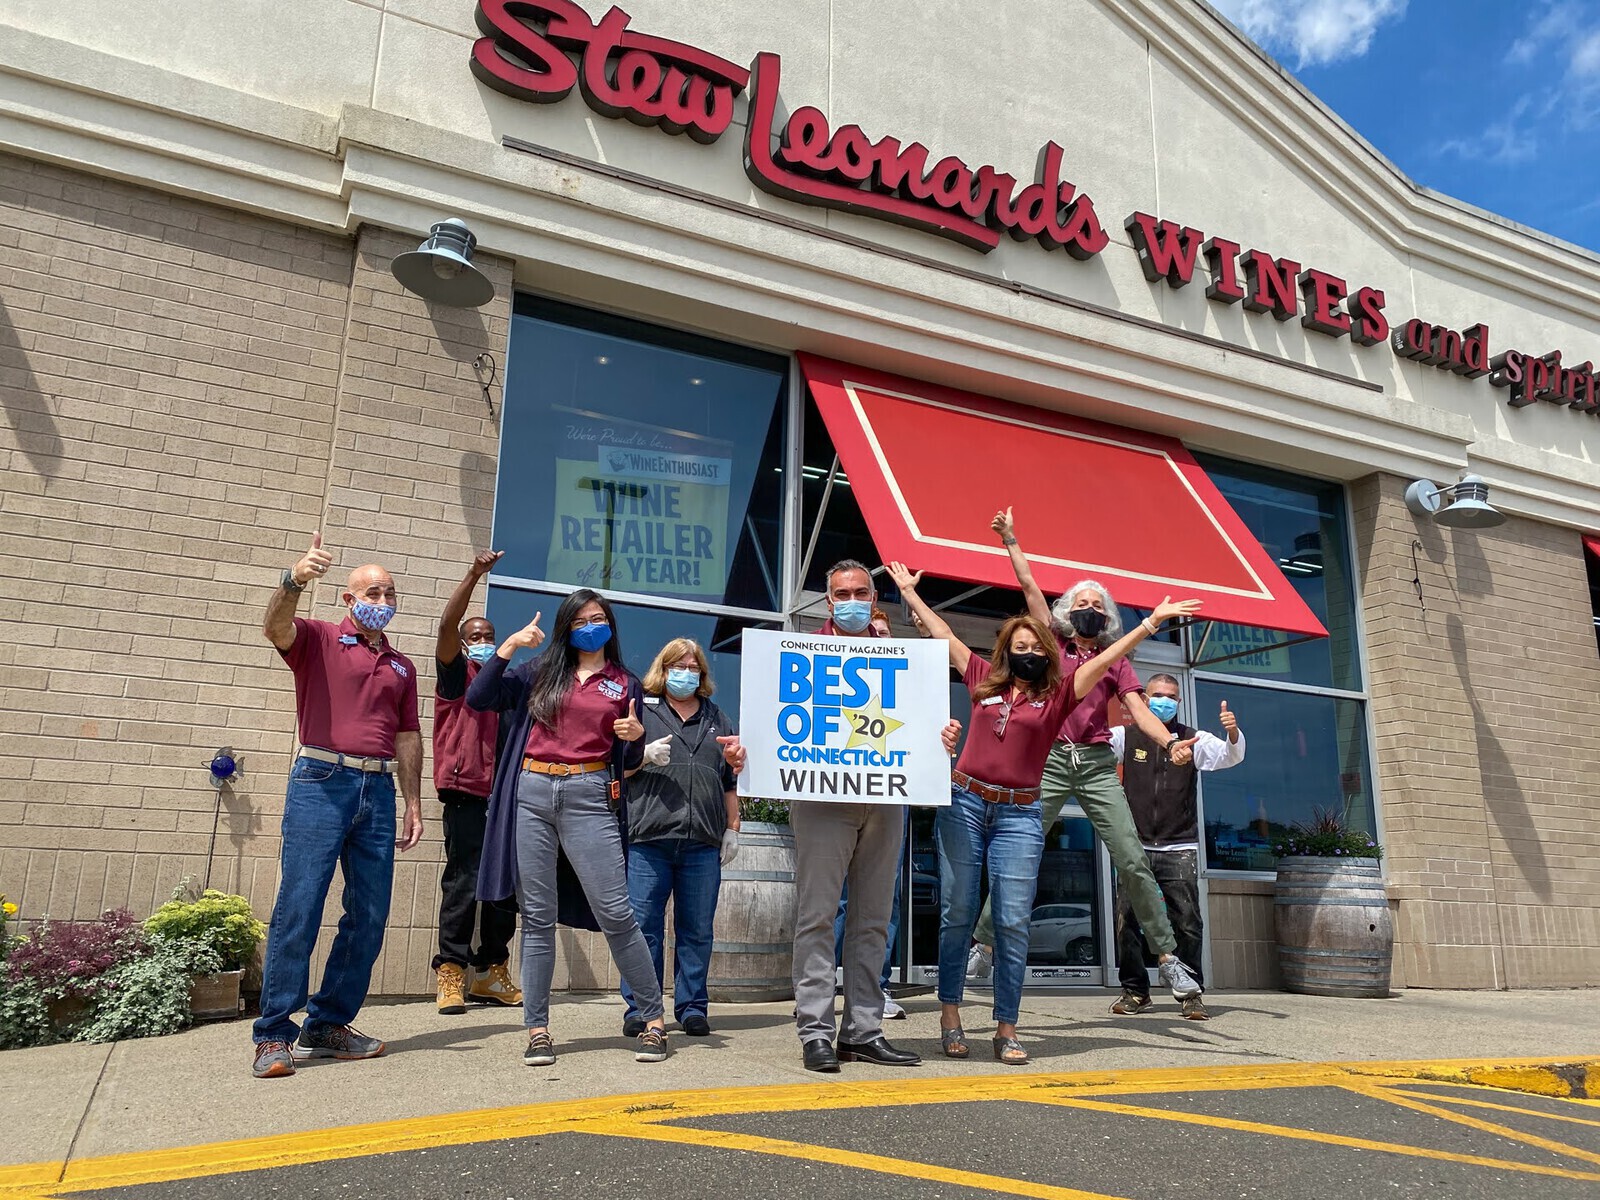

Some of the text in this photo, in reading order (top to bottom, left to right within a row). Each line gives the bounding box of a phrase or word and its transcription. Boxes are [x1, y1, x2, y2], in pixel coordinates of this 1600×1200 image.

[468, 0, 749, 144] Stew
[742, 52, 1108, 260] Leonard's
[1124, 211, 1389, 347] WINES
[1394, 318, 1491, 379] and
[566, 424, 597, 441] We're
[599, 427, 637, 445] Proud
[591, 479, 682, 519] WINE
[560, 514, 714, 560] RETAILER
[577, 561, 598, 583] of
[627, 557, 701, 586] YEAR!
[780, 640, 906, 655] CONNECTICUT MAGAZINE'S
[779, 651, 908, 709] BEST
[777, 704, 841, 745] OF
[852, 713, 886, 739] '20
[777, 745, 907, 767] CONNECTICUT
[779, 768, 908, 797] WINNER
